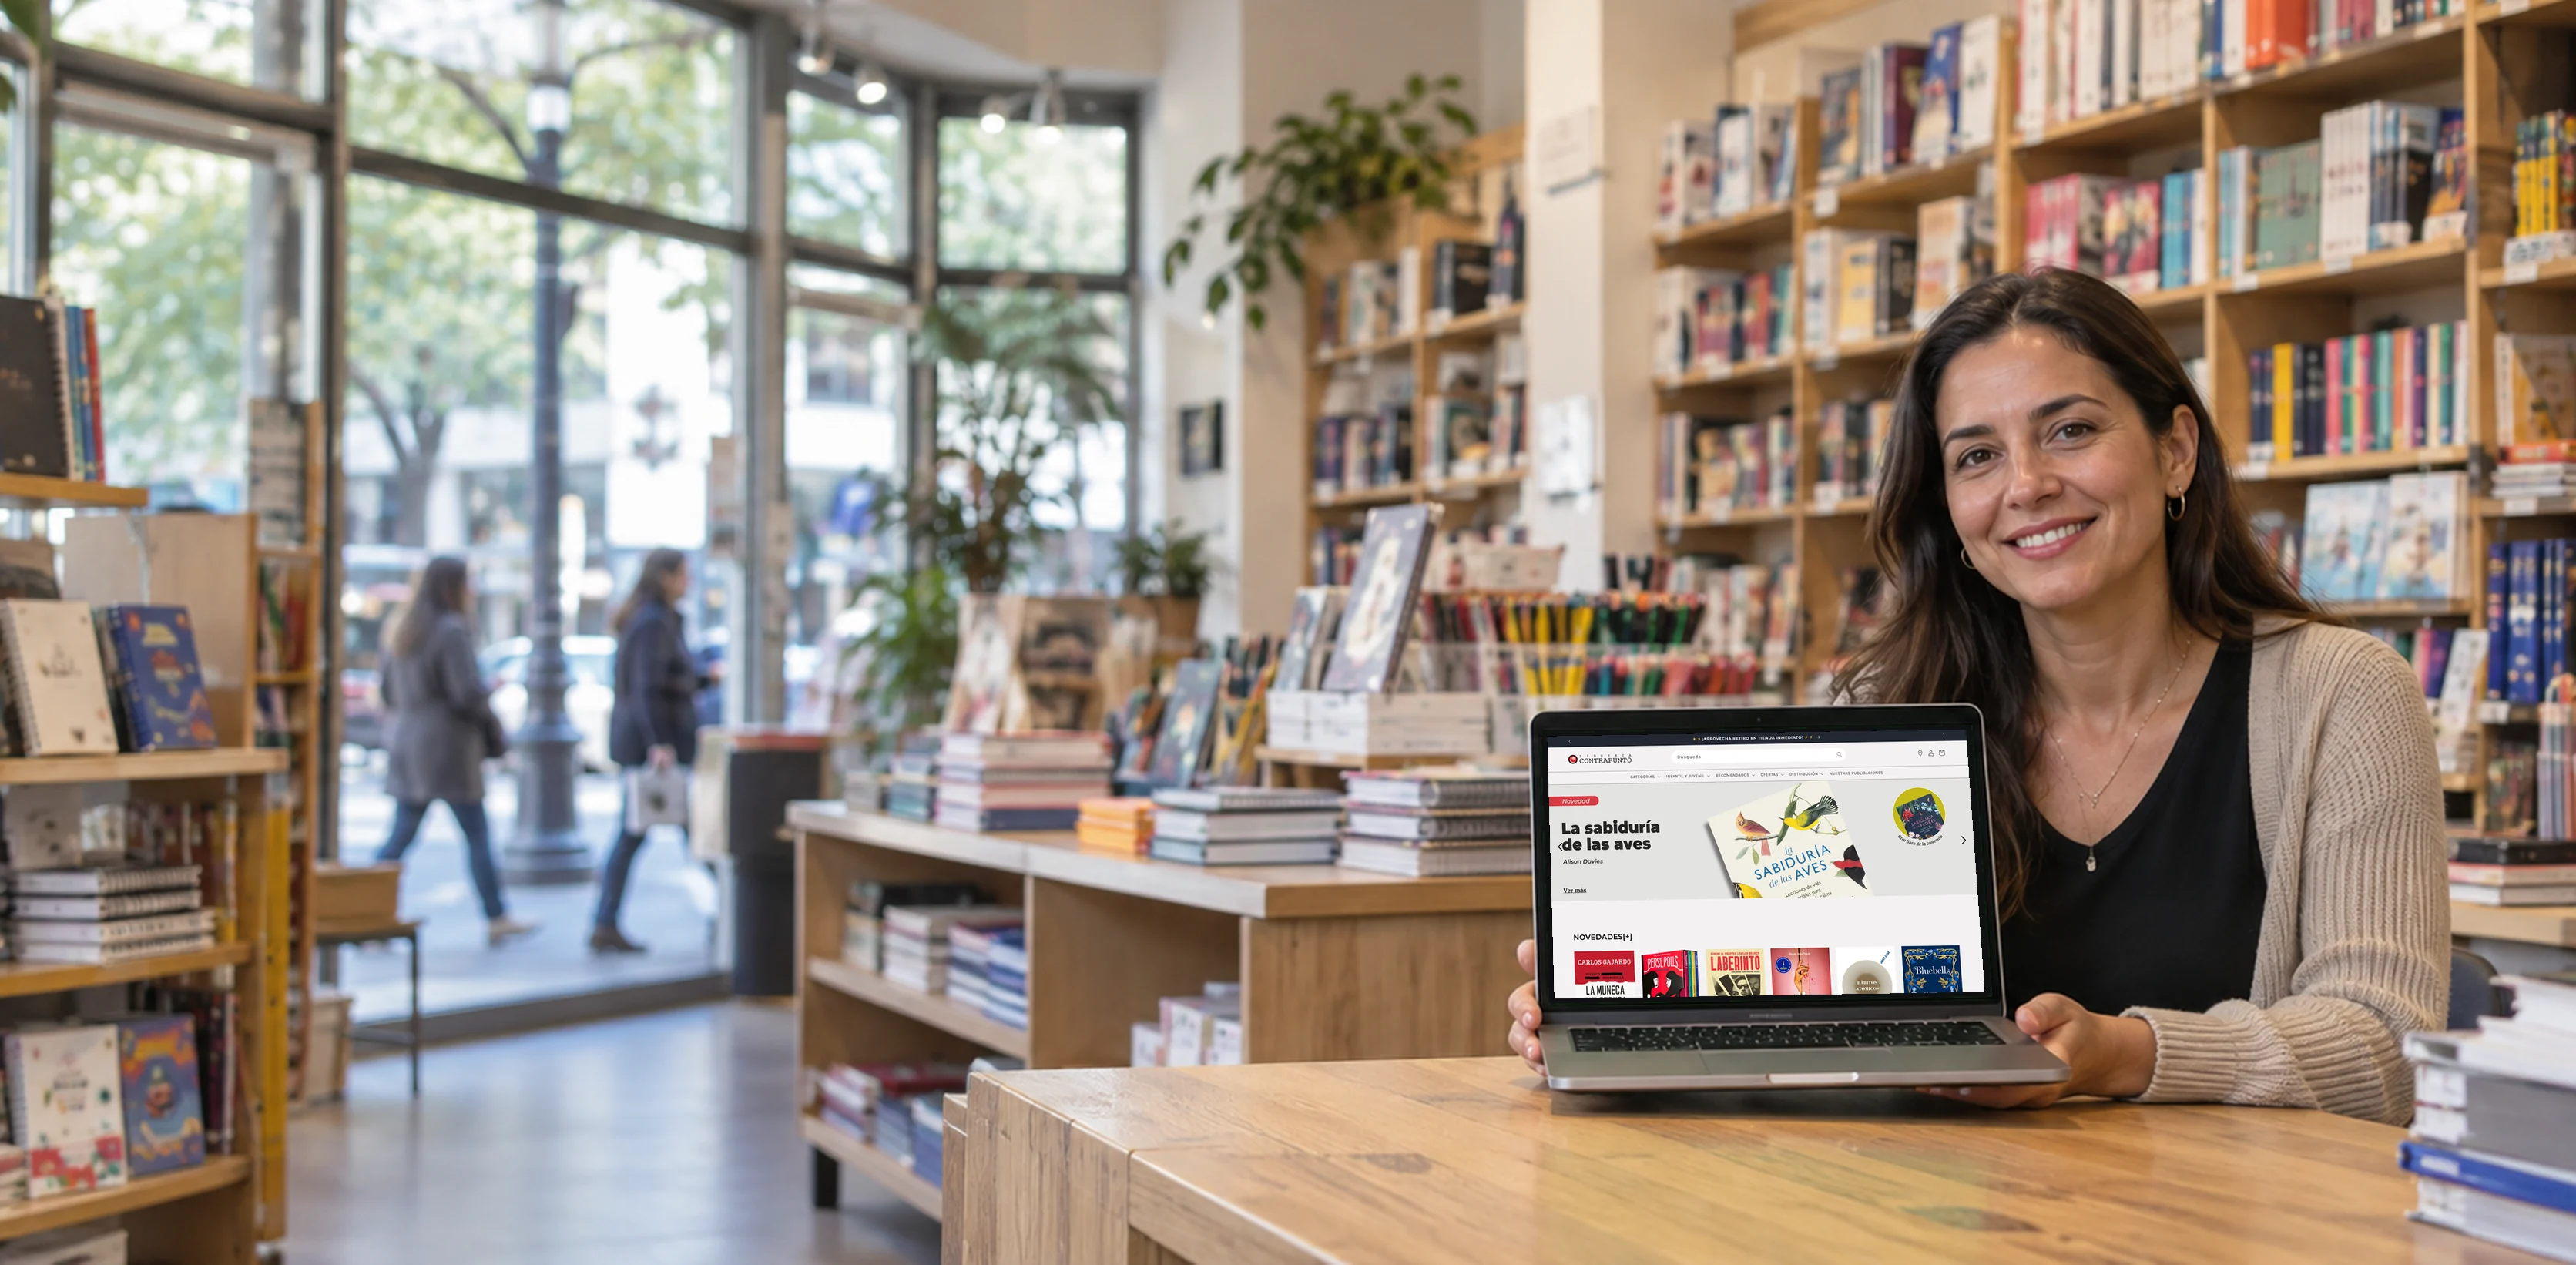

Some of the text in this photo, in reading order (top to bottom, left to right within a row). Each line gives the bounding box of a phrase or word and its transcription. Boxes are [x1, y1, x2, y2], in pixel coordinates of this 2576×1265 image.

[1561, 820, 1660, 834] La sabiduría
[1561, 837, 1652, 851] de las aves
[1784, 847, 1793, 856] La
[1754, 844, 1831, 880] SABIDURÍA
[1769, 860, 1828, 888] de las AVES
[1784, 887, 1806, 898] Lecciones
[1647, 955, 1679, 969] PERSEPOLIS
[1710, 955, 1760, 971] LABERINTO
[1913, 965, 1950, 975] Bluebells
[1585, 984, 1625, 995] LA MUÑECA
